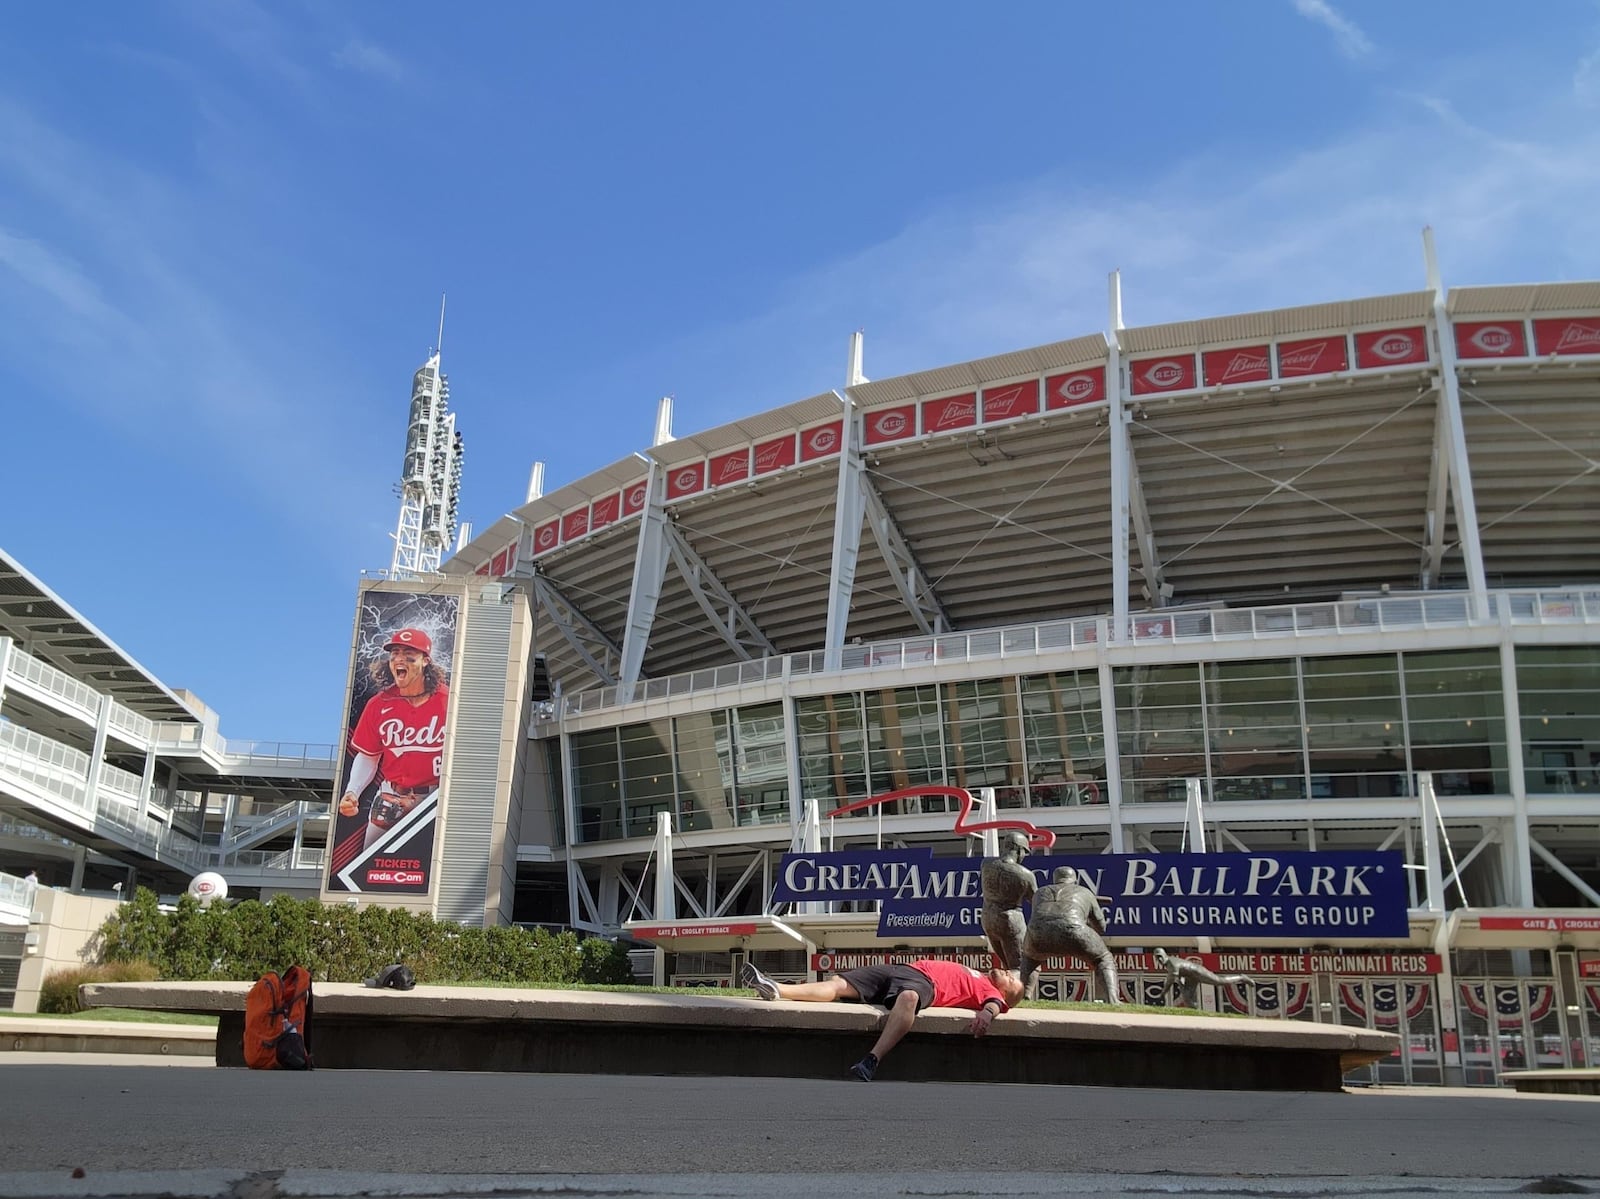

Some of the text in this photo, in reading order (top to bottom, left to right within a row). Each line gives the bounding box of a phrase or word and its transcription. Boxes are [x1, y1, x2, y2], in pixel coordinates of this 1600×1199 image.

[379, 715, 447, 747] Reds
[374, 858, 420, 869] TICKETS
[784, 858, 907, 893] GREAT
[1120, 858, 1237, 896] BALL
[1242, 857, 1375, 896] PARK
[886, 911, 939, 927] Presented
[939, 912, 955, 929] by
[1152, 906, 1283, 926] INSURANCE
[1295, 906, 1376, 926] GROUP
[1523, 919, 1546, 929] GATE
[1547, 918, 1558, 930] A
[671, 927, 678, 937] A
[834, 954, 886, 970] HAMILTON
[1113, 954, 1149, 970] XHALL
[1219, 955, 1256, 971] HOME
[1260, 955, 1277, 971] OF
[1280, 955, 1305, 971] THE
[1310, 955, 1387, 972] CINCINNATI
[1391, 955, 1428, 972] REDS
